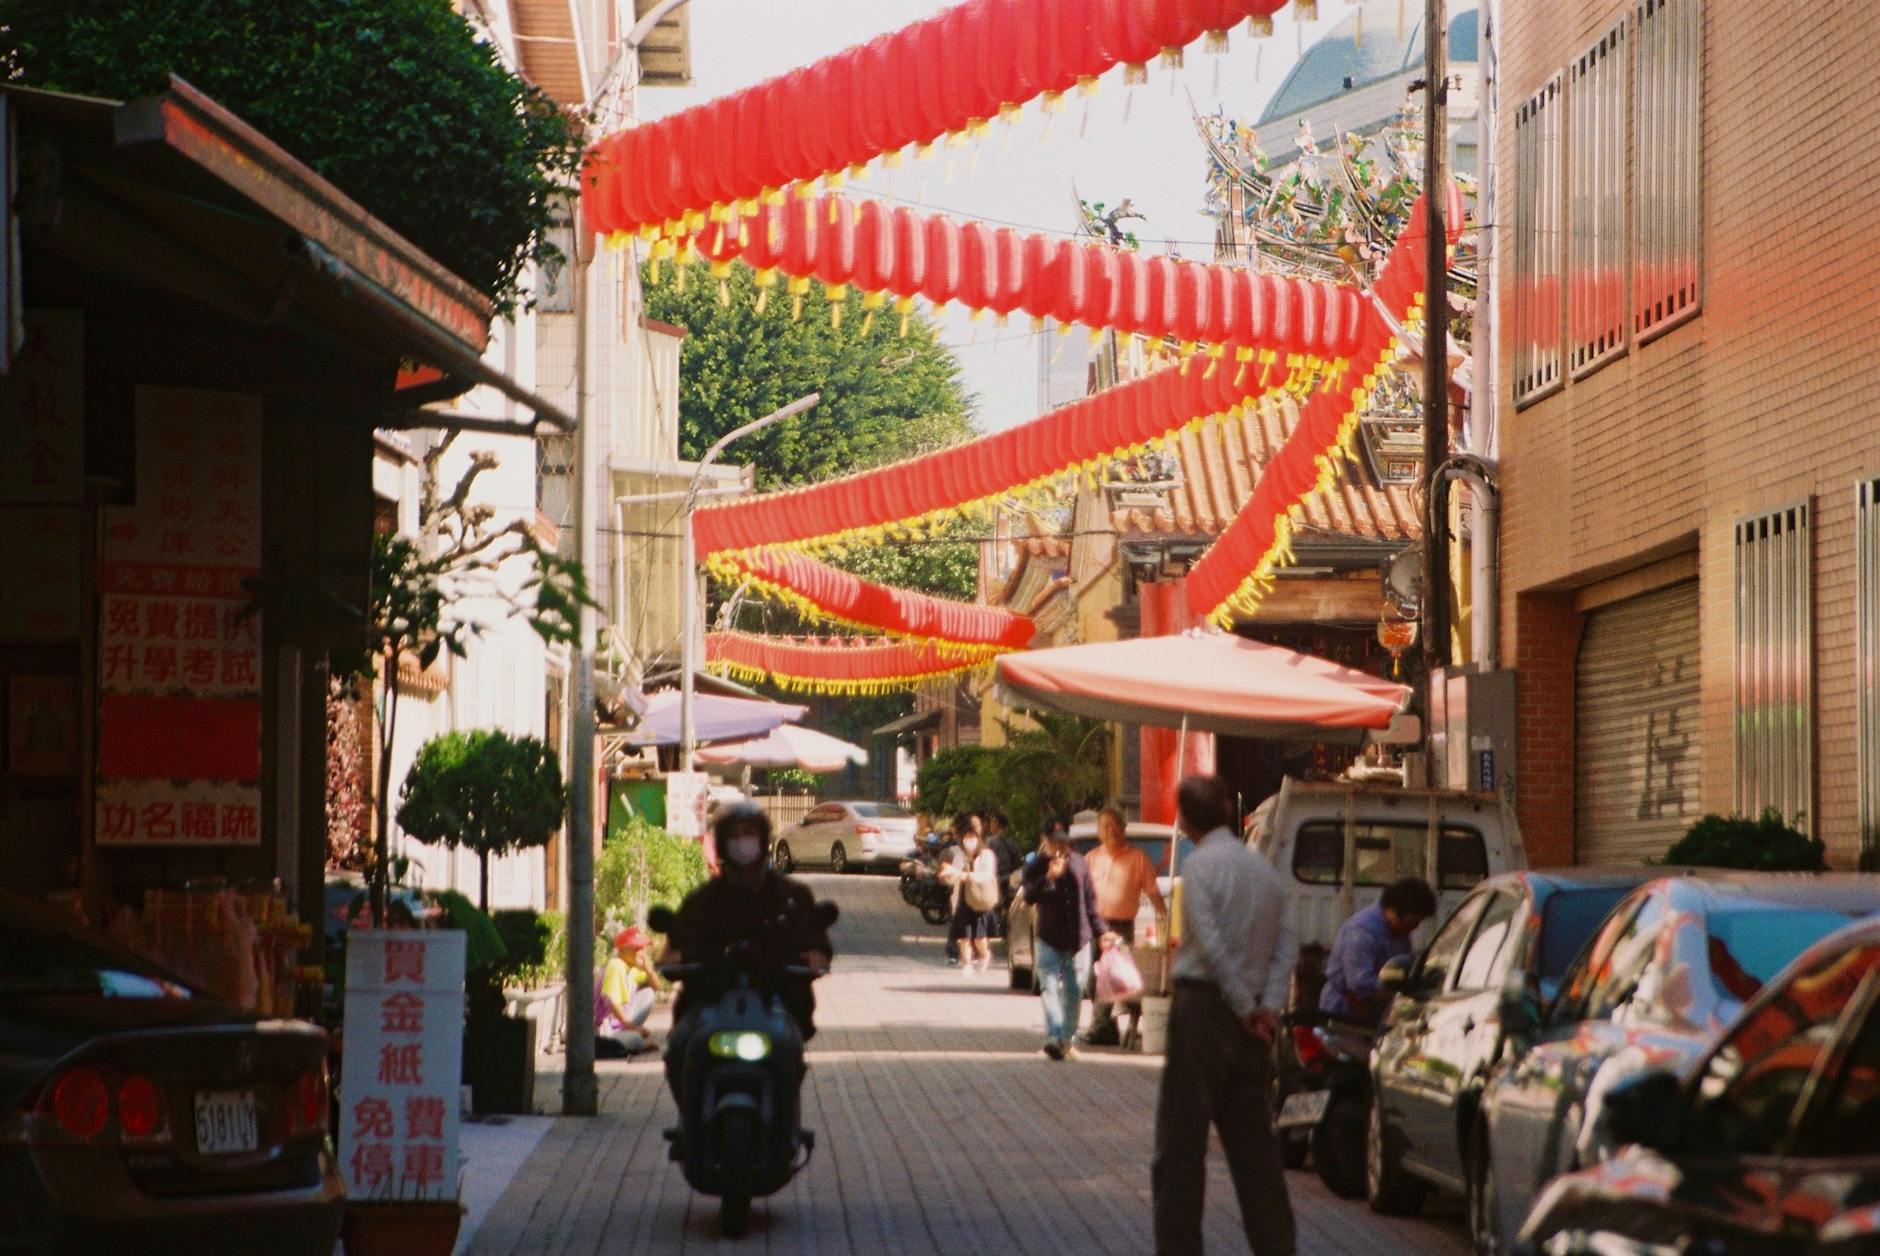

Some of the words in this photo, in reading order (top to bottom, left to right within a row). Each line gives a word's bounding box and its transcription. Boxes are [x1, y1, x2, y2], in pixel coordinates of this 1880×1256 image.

[108, 600, 257, 641] 免費提供
[106, 644, 257, 685] 升學考試
[102, 801, 257, 841] 功名福疏
[378, 940, 427, 1085] 買金紙
[352, 1095, 446, 1141] 免費
[350, 1143, 446, 1188] 停車
